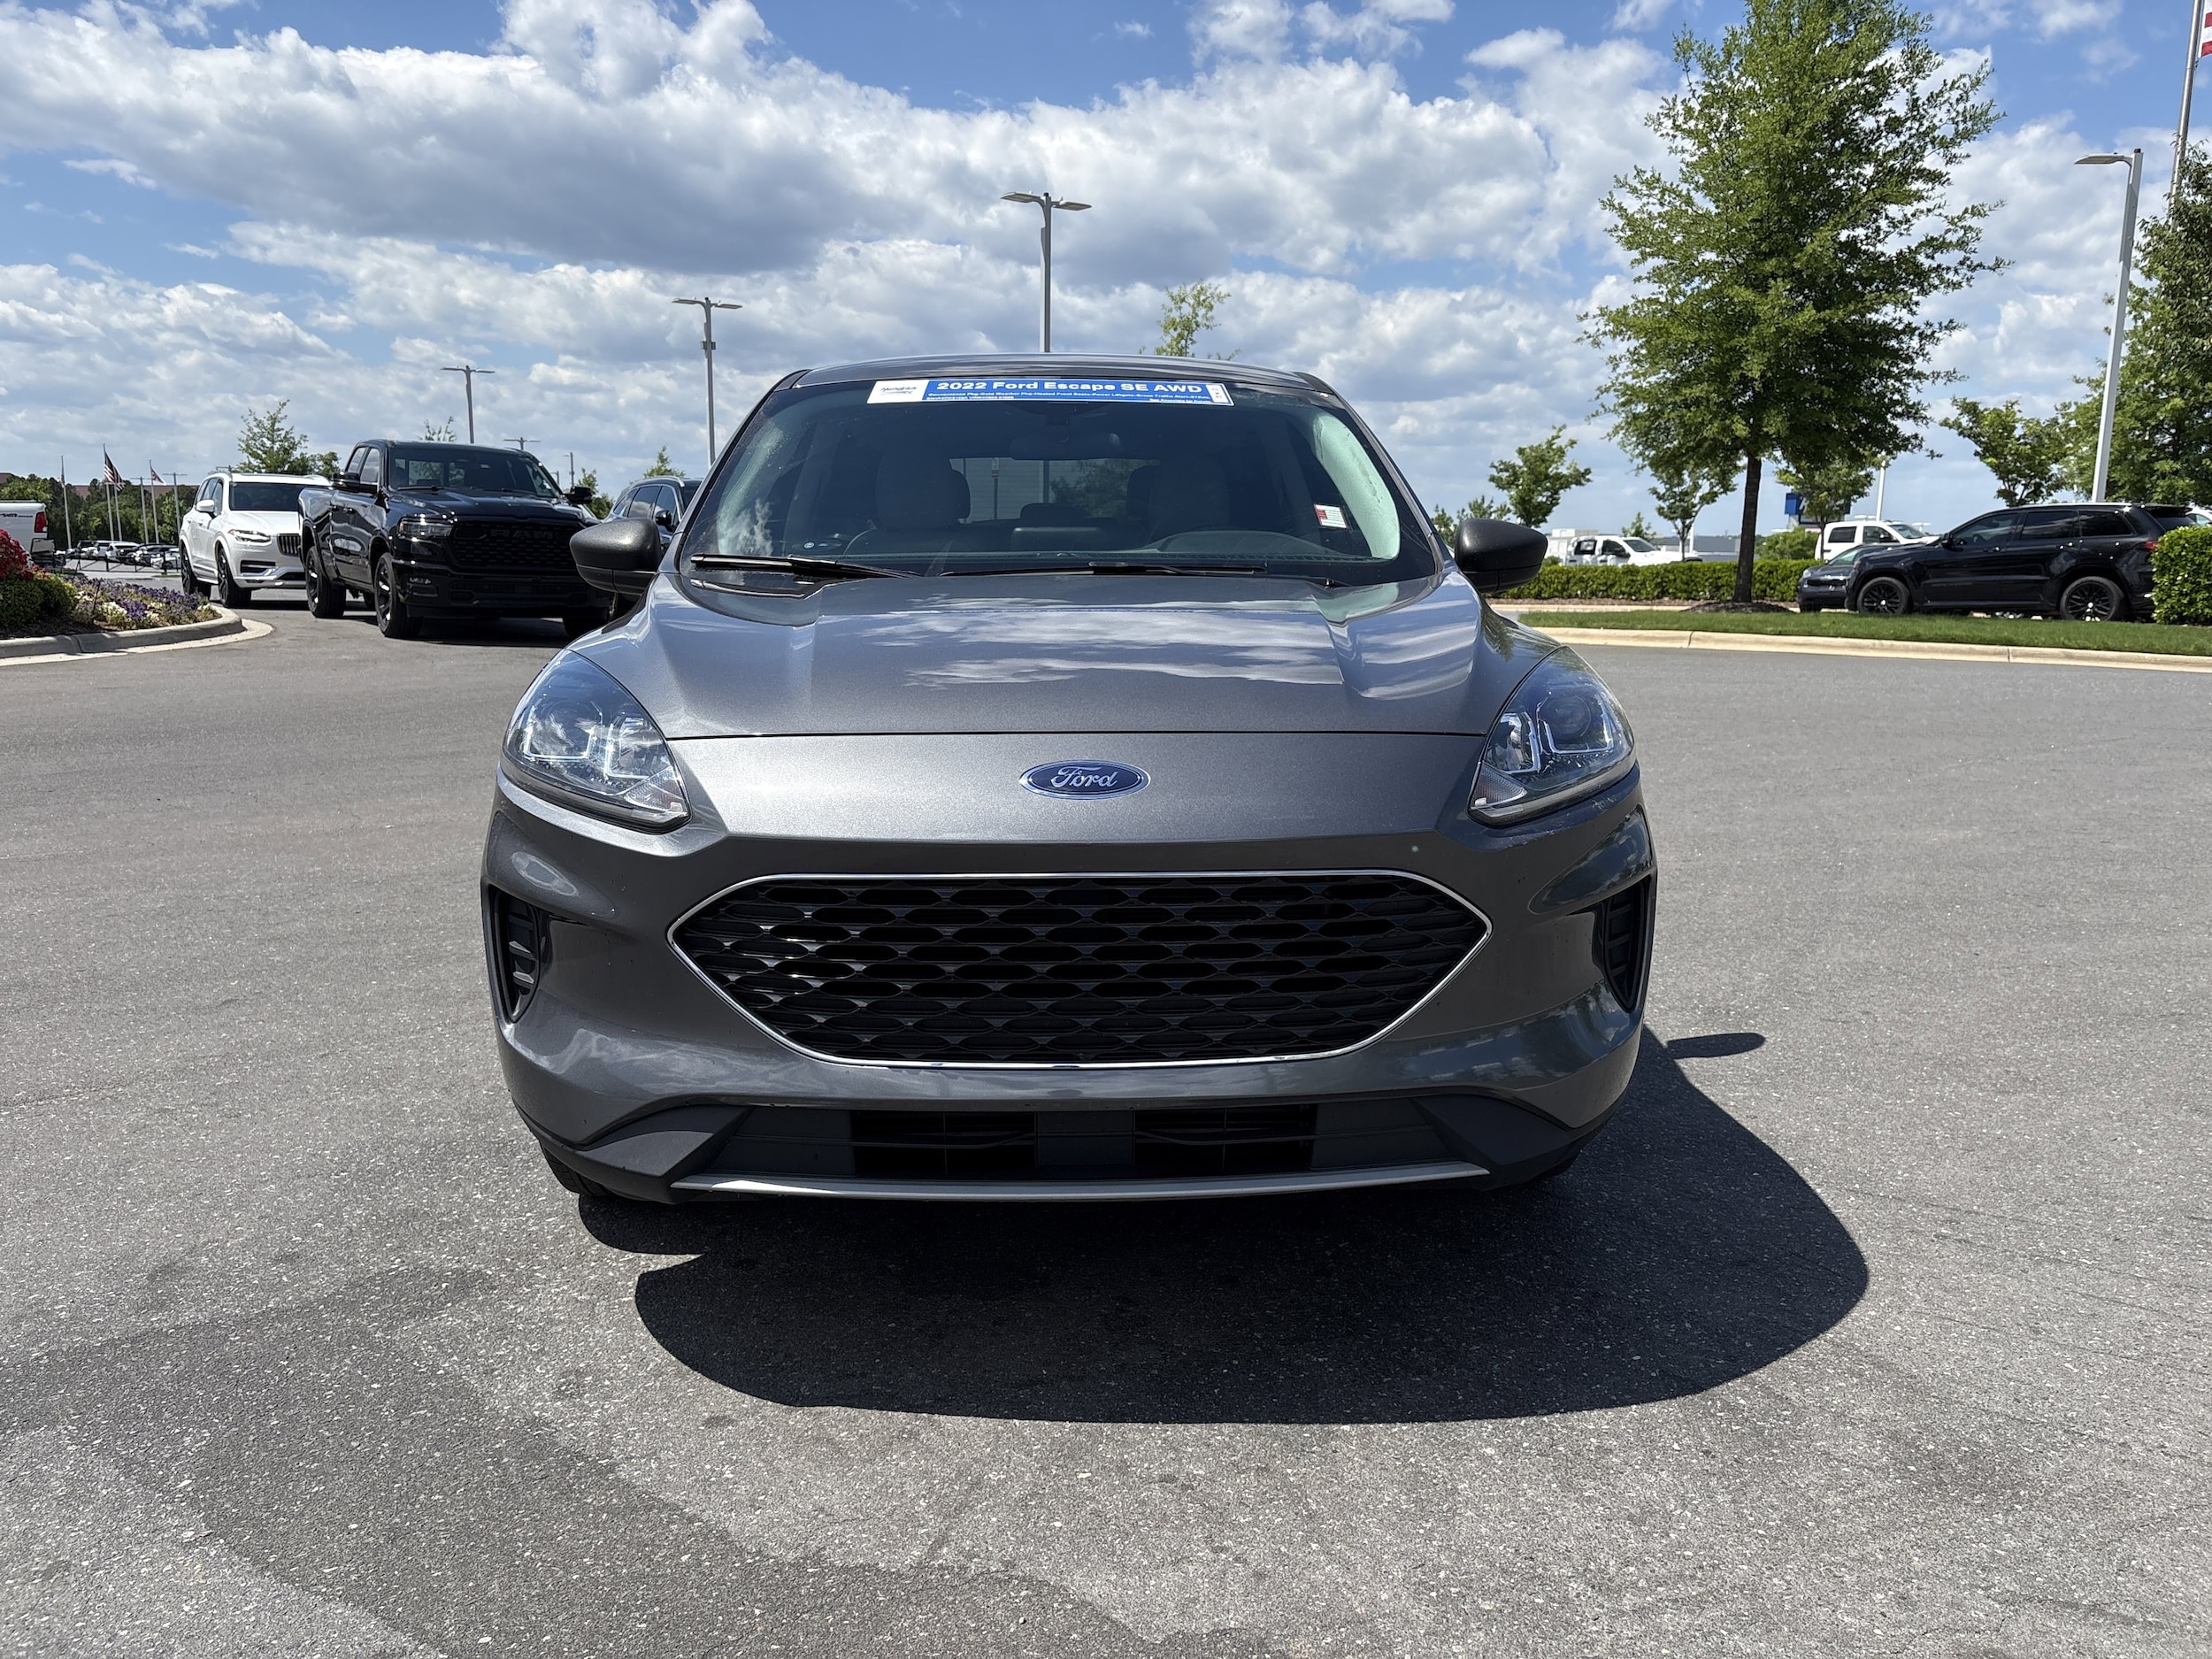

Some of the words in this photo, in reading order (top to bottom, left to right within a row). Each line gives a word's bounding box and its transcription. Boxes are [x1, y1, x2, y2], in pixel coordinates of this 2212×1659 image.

[936, 381, 987, 390] 2022
[992, 381, 1039, 390] Ford
[1043, 381, 1116, 391] Escape
[1153, 384, 1202, 393] AWD
[490, 529, 553, 539] RAM
[1050, 766, 1118, 787] Ford
